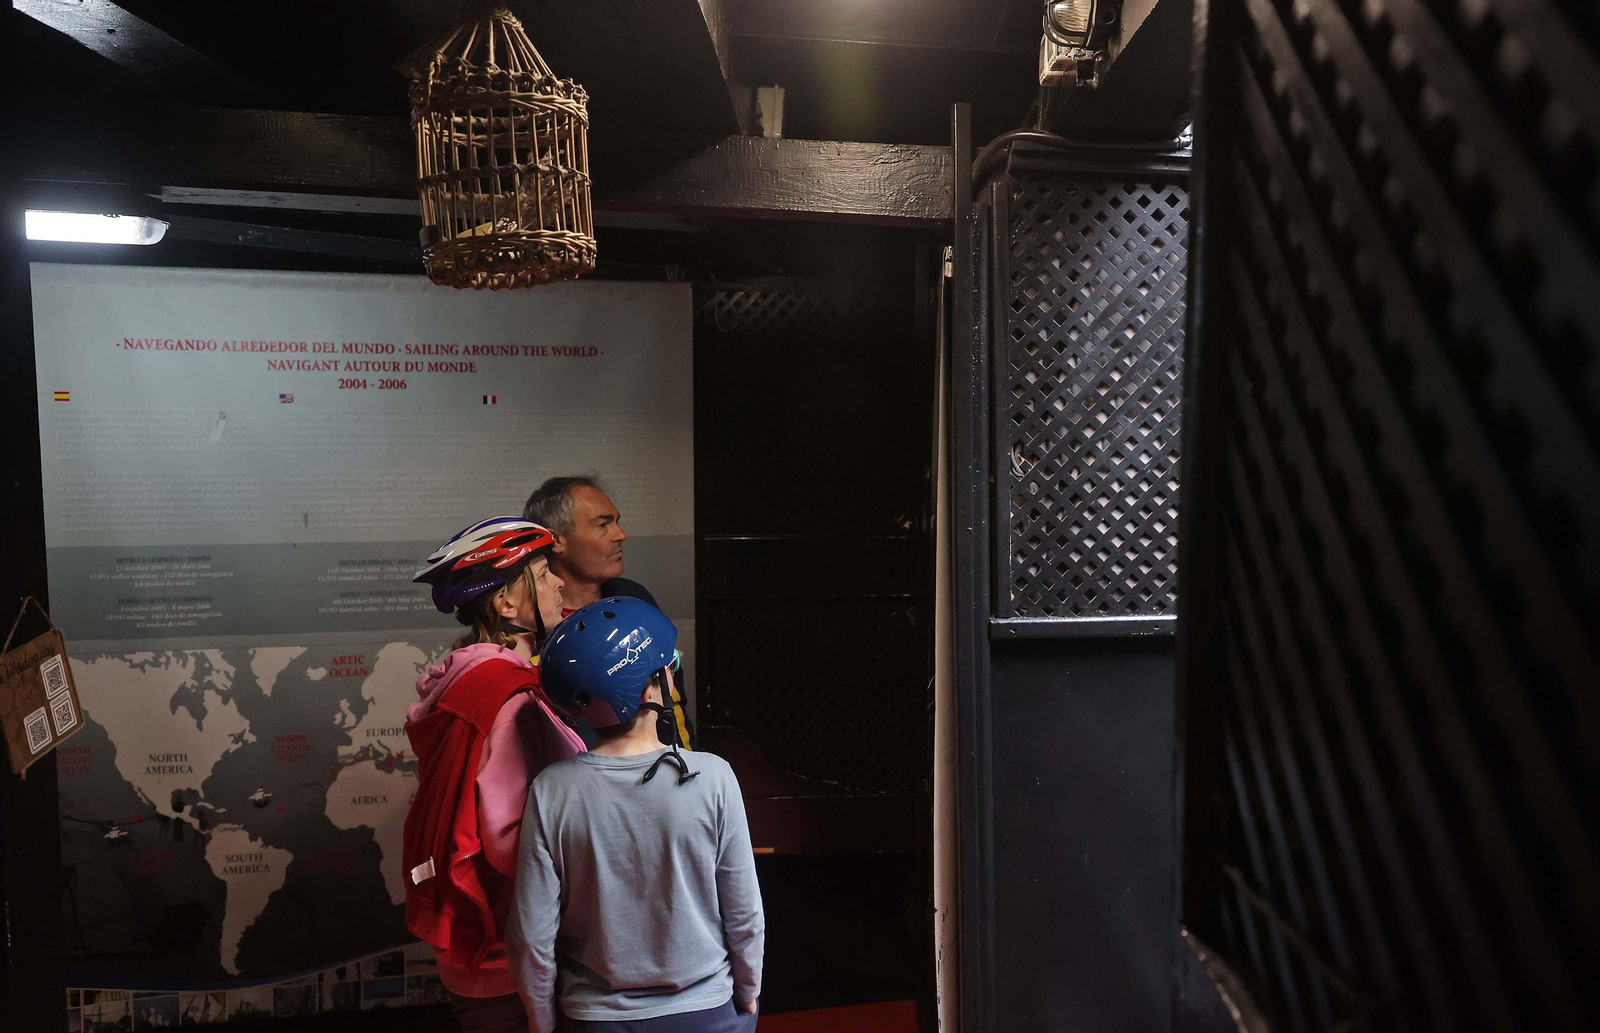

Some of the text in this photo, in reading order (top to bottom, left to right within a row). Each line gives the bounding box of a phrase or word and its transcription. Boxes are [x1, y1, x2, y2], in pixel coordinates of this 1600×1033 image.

[123, 338, 598, 358] NAVEGANDO ALREDEDOR DEL MUNDO SAILING AROUND THE WORLD
[267, 359, 477, 373] NAVIGANT AUTOUR DU MONDE
[338, 378, 368, 390] 2004
[378, 378, 407, 390] 2006
[331, 654, 366, 666] ARTIC
[329, 667, 368, 678] OCEAN
[148, 753, 188, 763] NORTH
[144, 765, 193, 775] AMERICA
[350, 795, 389, 805] AFRICA
[224, 853, 263, 863] SOUTH
[221, 864, 271, 875] AMERICA
